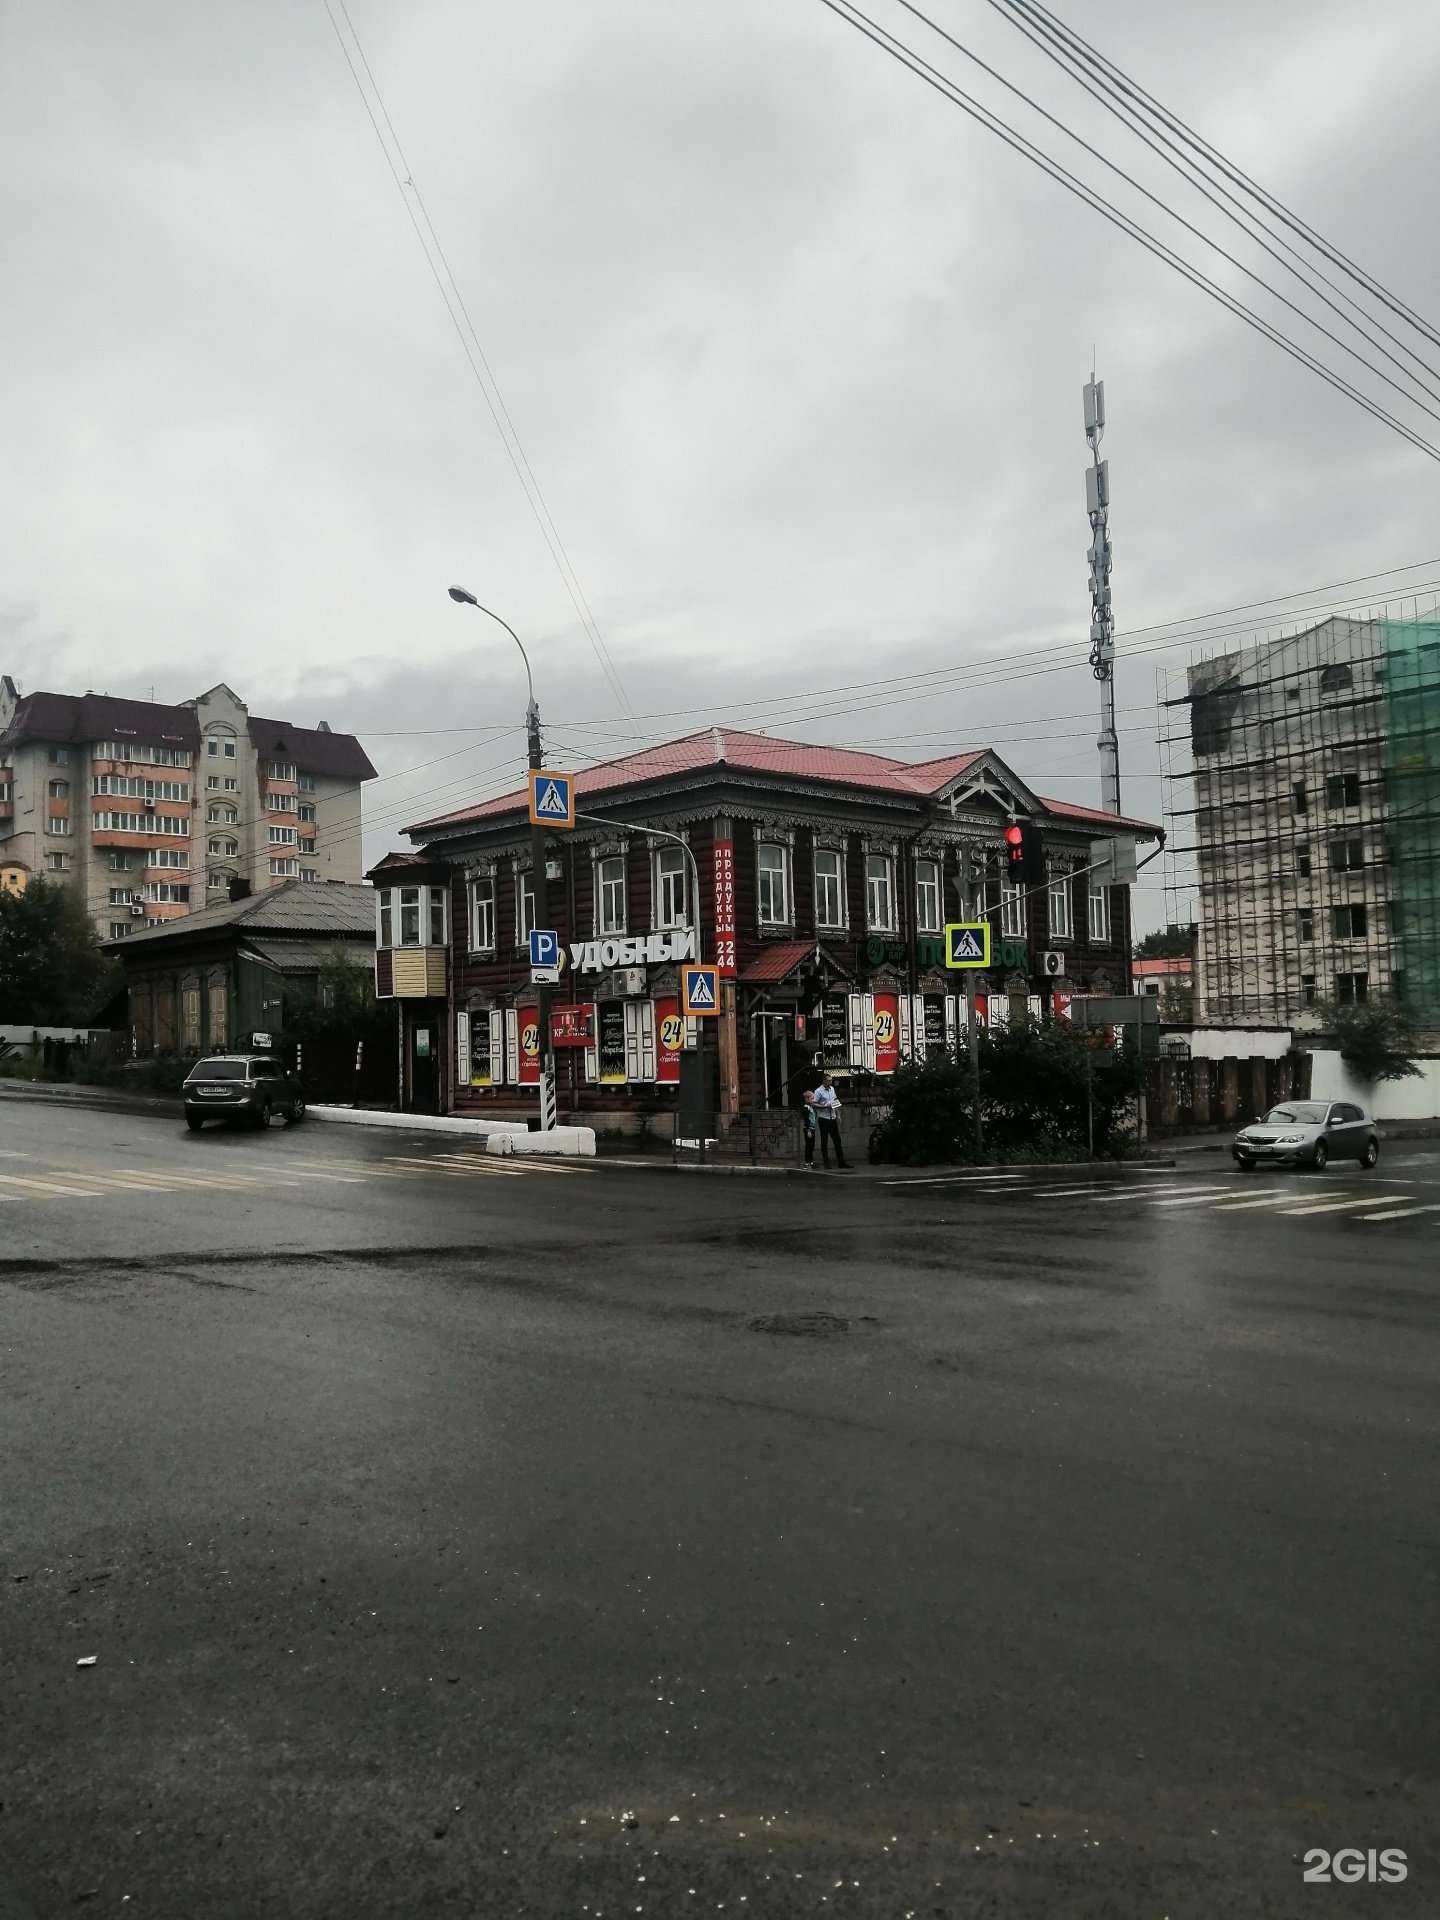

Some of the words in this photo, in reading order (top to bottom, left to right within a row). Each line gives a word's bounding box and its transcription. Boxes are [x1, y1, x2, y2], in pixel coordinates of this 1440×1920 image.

[538, 934, 553, 961] P
[570, 926, 696, 974] УДОБНЫЙ
[662, 1020, 682, 1043] 24
[875, 1015, 892, 1037] 24
[524, 1029, 540, 1049] 24
